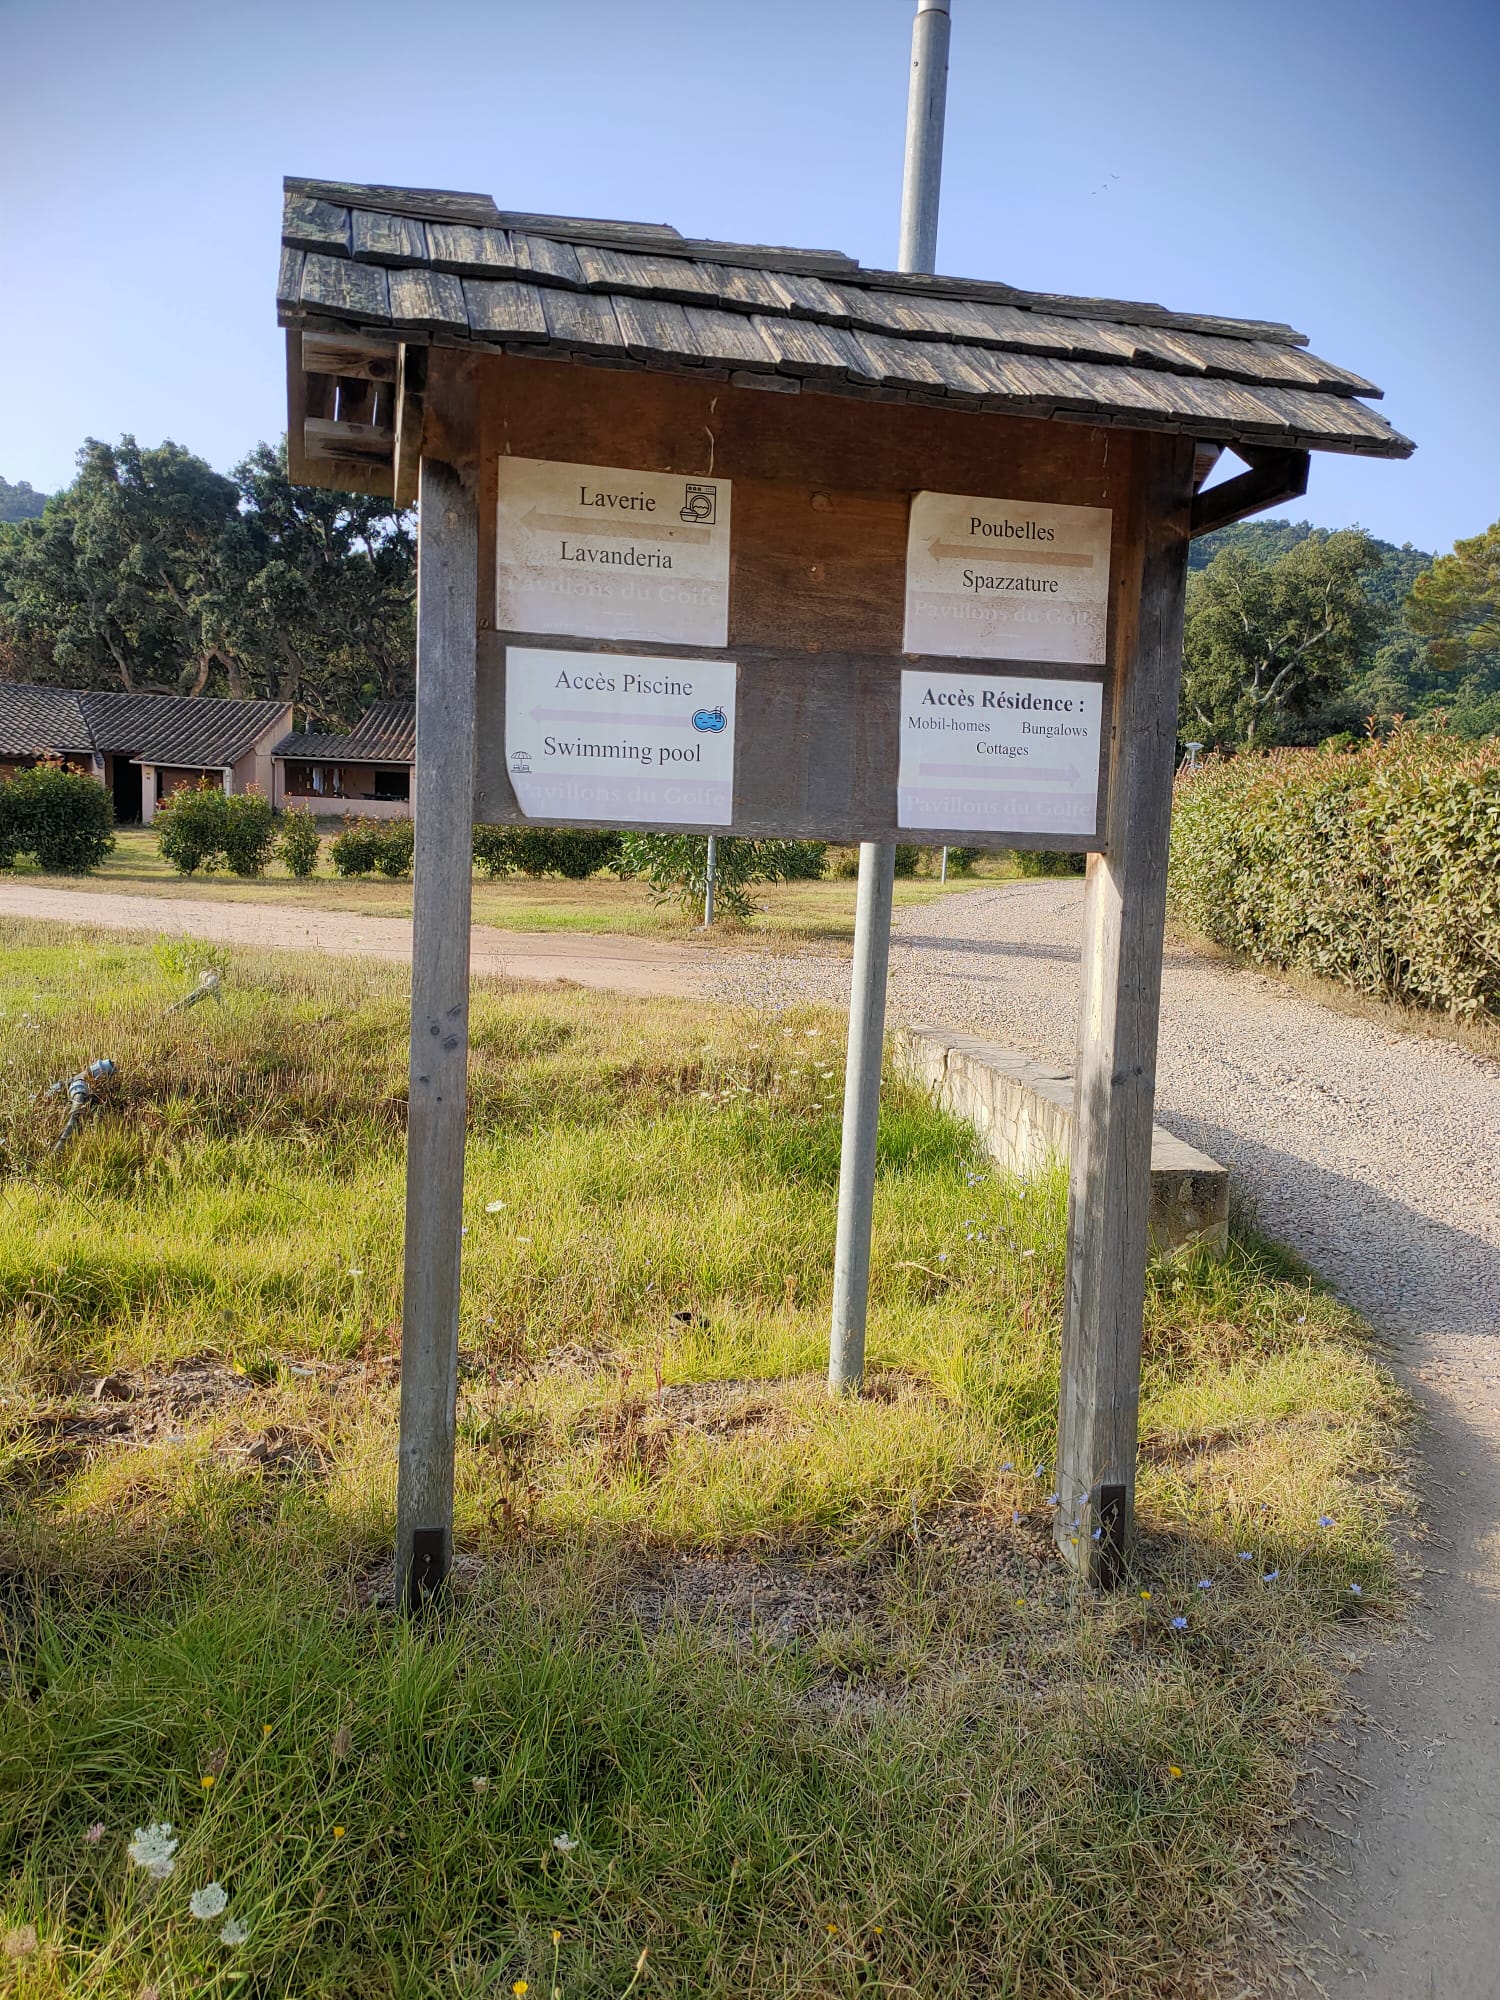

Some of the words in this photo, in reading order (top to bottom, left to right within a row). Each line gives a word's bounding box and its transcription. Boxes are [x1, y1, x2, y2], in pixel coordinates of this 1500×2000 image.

[579, 486, 657, 512] Laverie
[969, 517, 1055, 541] Poubelles
[560, 541, 673, 569] Lavanderia
[962, 569, 1059, 593] Spazzature
[554, 669, 615, 692] Accès
[623, 674, 693, 696] Piscine
[921, 687, 975, 707] Accès
[982, 690, 1073, 712] Résidence
[908, 716, 991, 733] Mobil-homes
[1021, 721, 1088, 739] Bungalows
[543, 736, 653, 765] Swimming
[659, 744, 701, 765] pool
[976, 741, 1029, 758] Cottages
[628, 784, 656, 803] du
[664, 786, 727, 808] Golfe
[906, 794, 997, 815] Pavillons
[1004, 798, 1030, 817] du
